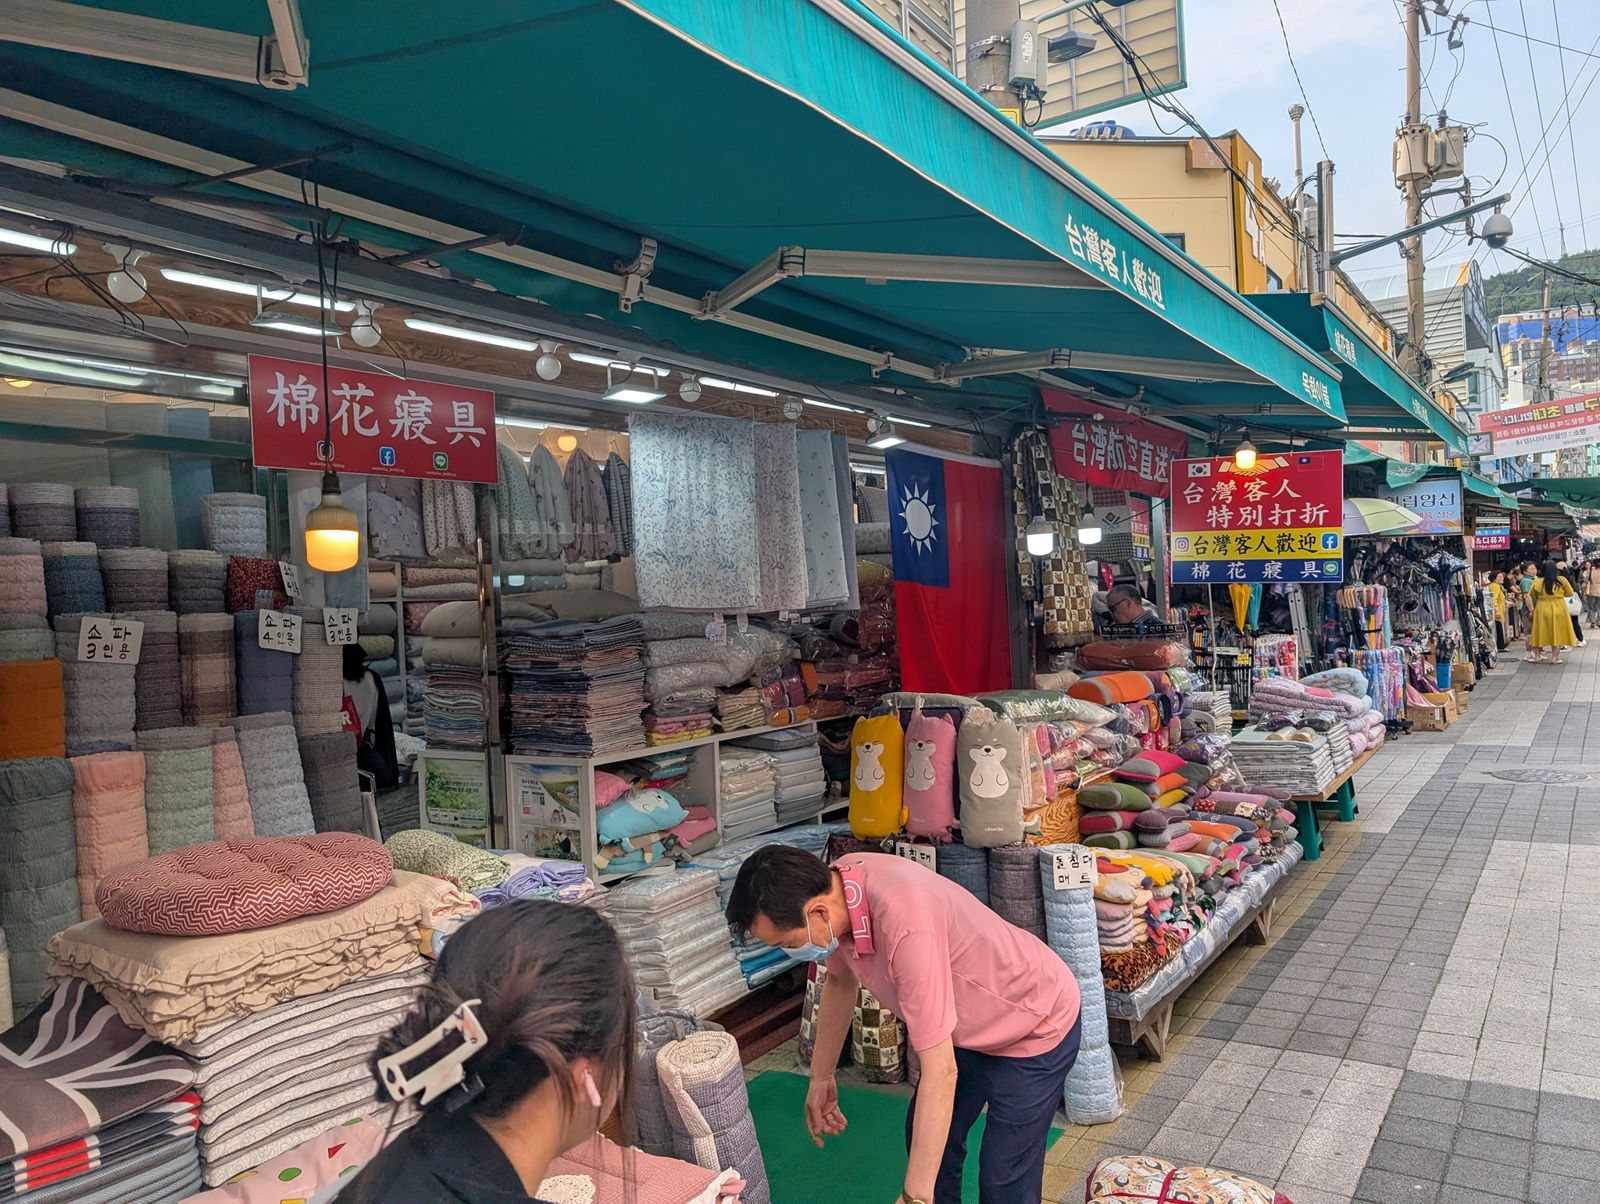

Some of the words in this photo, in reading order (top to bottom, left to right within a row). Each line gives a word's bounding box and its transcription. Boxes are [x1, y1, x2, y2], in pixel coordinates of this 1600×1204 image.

[1064, 214, 1166, 312] 台灣客人歡迎
[1182, 478, 1302, 505] 台灣客人
[1206, 501, 1330, 529] 特別打折
[1193, 533, 1319, 557] 台灣客人歡迎
